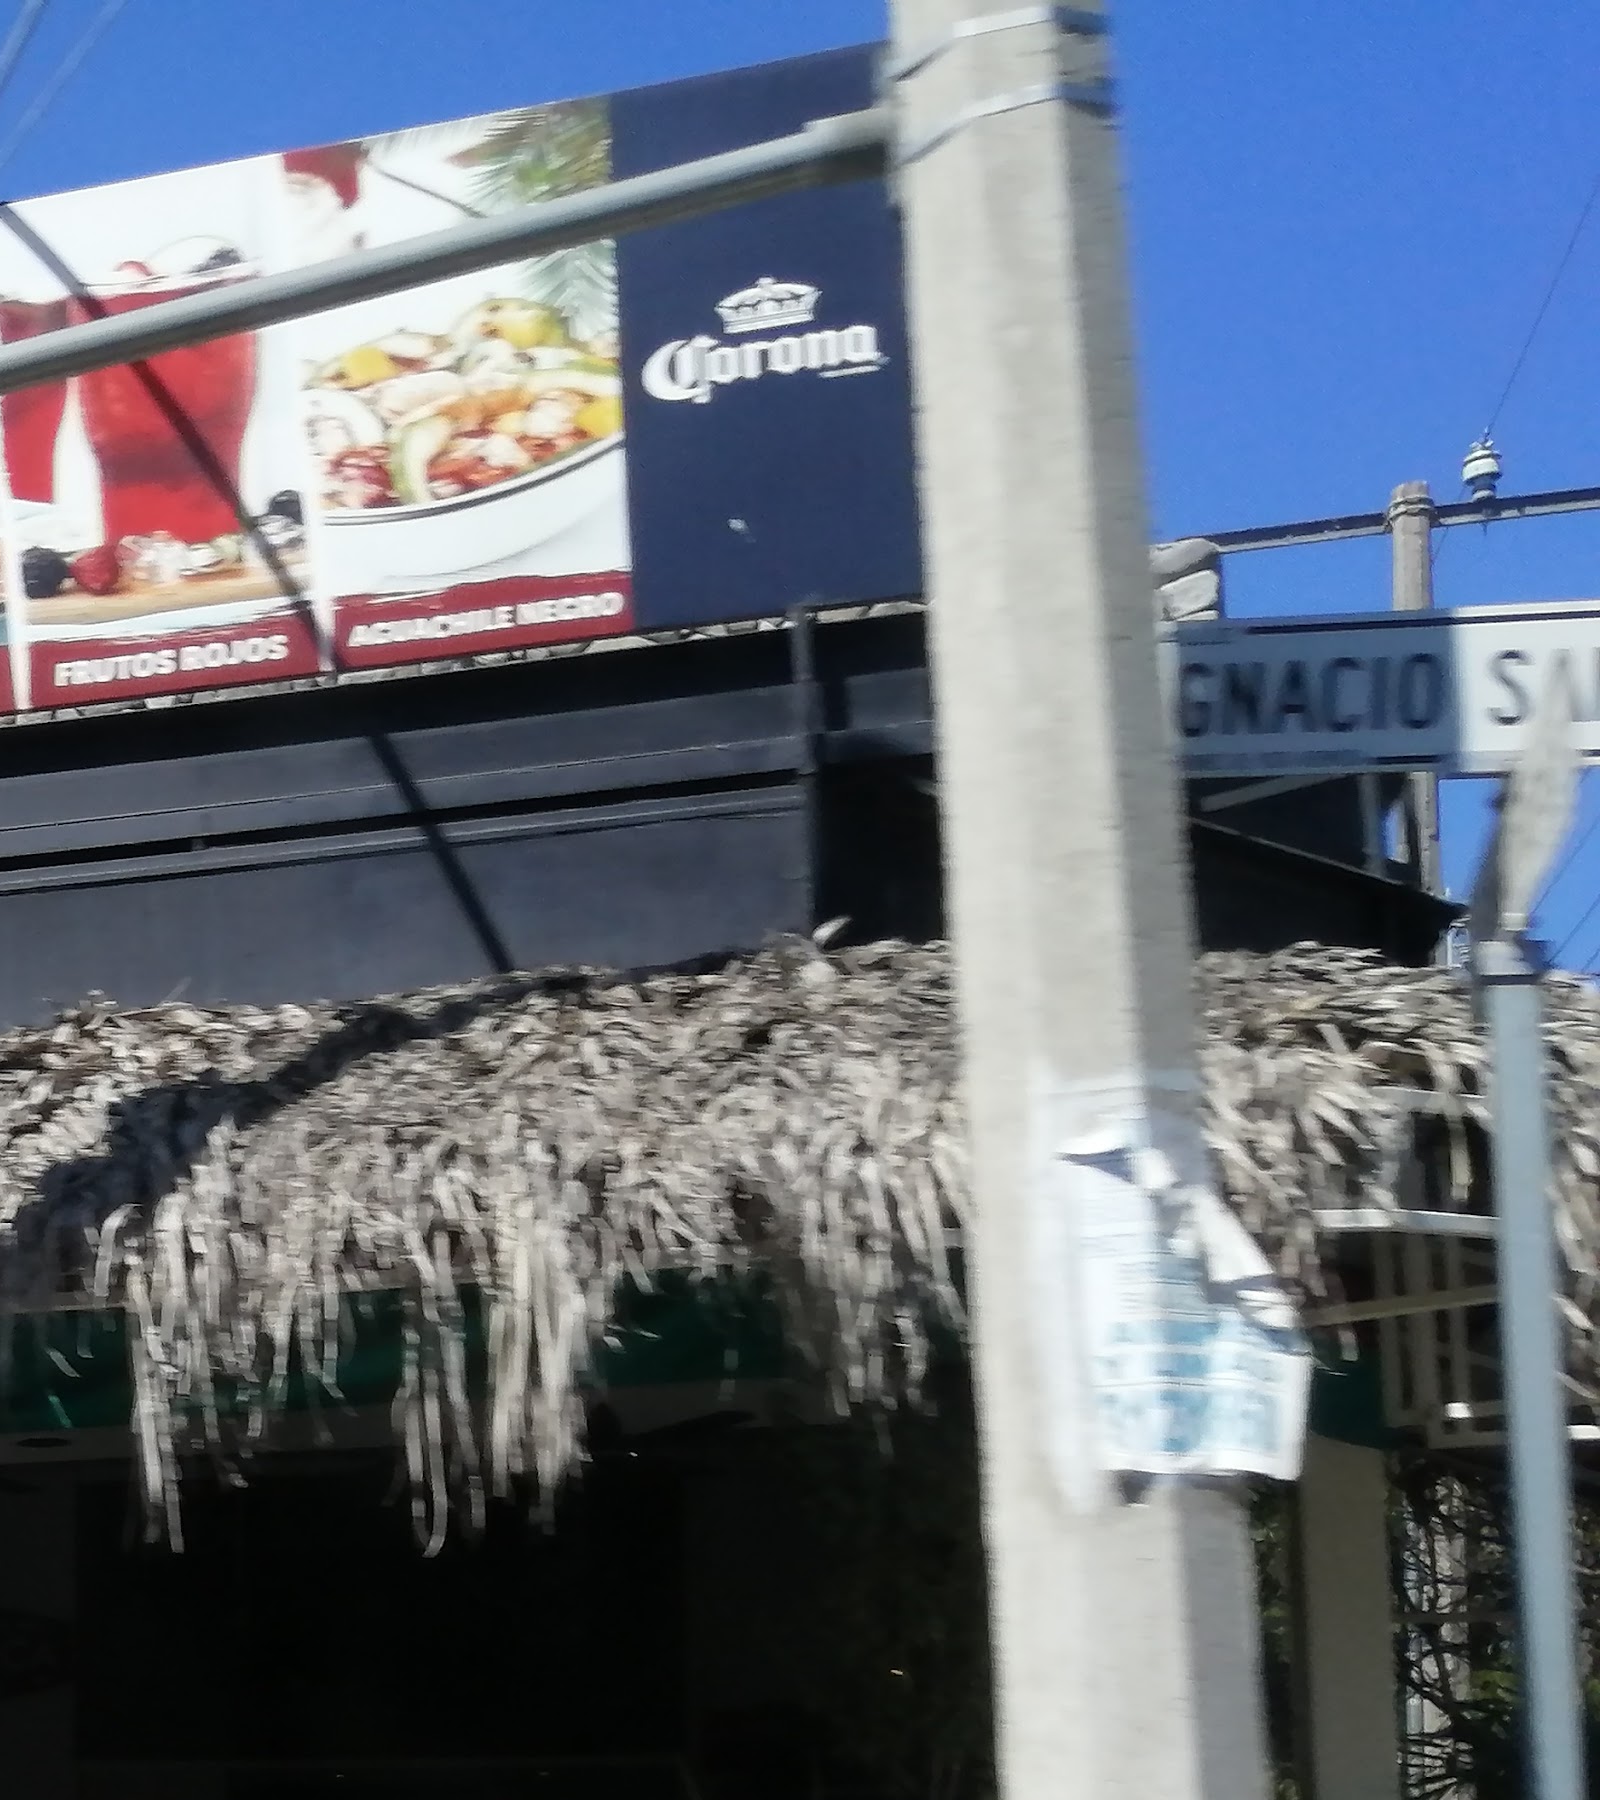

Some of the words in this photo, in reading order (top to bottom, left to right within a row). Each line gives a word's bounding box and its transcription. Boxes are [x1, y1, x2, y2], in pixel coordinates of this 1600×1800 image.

[641, 324, 888, 404] Corona
[349, 607, 515, 647] AGUACHILE
[516, 592, 625, 625] NEGRO
[53, 649, 178, 692] FRUTOS
[180, 634, 290, 676] ROJOS
[1178, 654, 1444, 738] GNACIO
